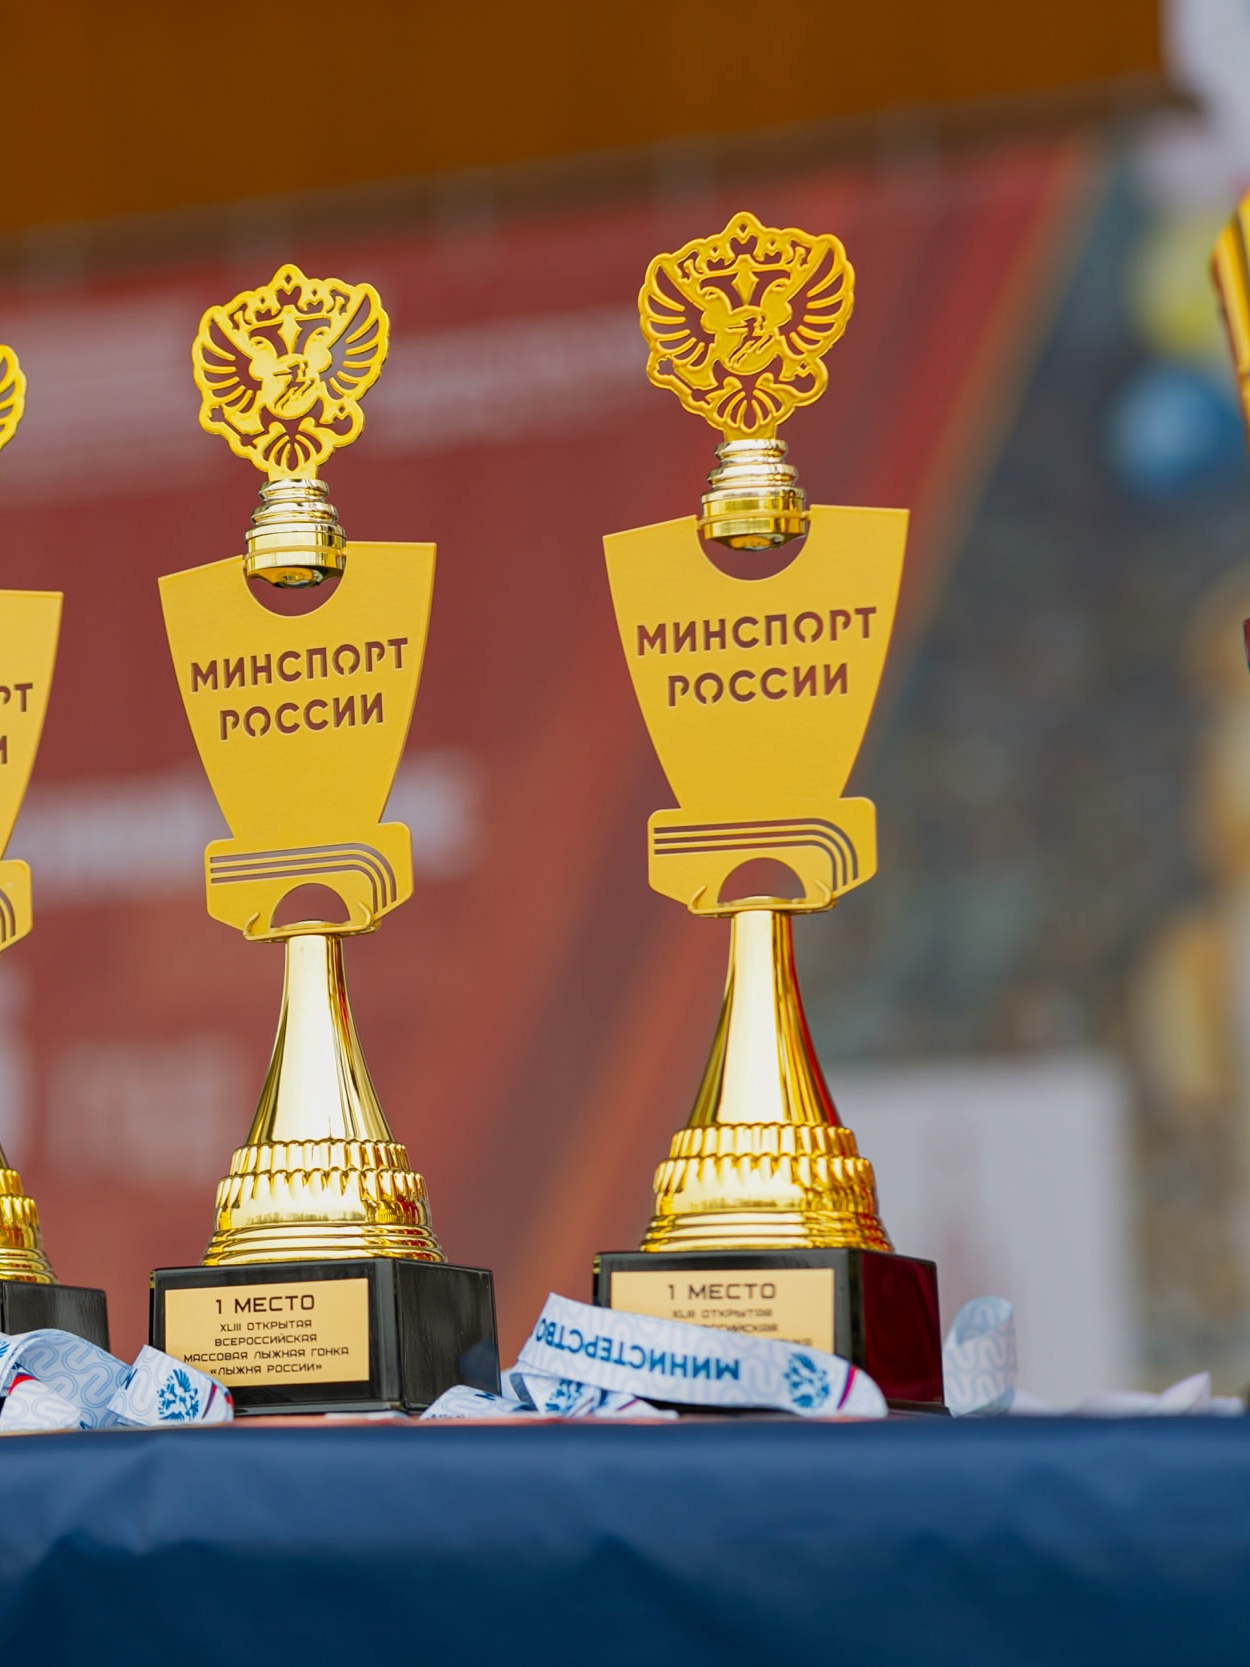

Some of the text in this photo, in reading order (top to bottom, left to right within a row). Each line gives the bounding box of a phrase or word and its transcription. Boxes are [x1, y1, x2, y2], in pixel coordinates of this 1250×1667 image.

[636, 607, 878, 656] МИНСПОРТ
[190, 637, 409, 693] МИНСПОРТ
[667, 662, 849, 708] РОССИИ
[219, 692, 384, 741] РОССИИ
[668, 1283, 776, 1300] 1 МЕСТО
[215, 1294, 315, 1314] 1 МЕСТО
[220, 1319, 312, 1332] XLIII ОТКРЫТАЯ
[214, 1333, 317, 1347] ВСЕРОССИЙСКАЯ
[536, 1317, 741, 1381] МИНИСТЕРСТВО
[184, 1346, 349, 1363] МАССОВАЯ ЛЫЖНАЯ ГОНКА
[210, 1363, 322, 1376] «ЛЫЖНЯ РОССИИ»
